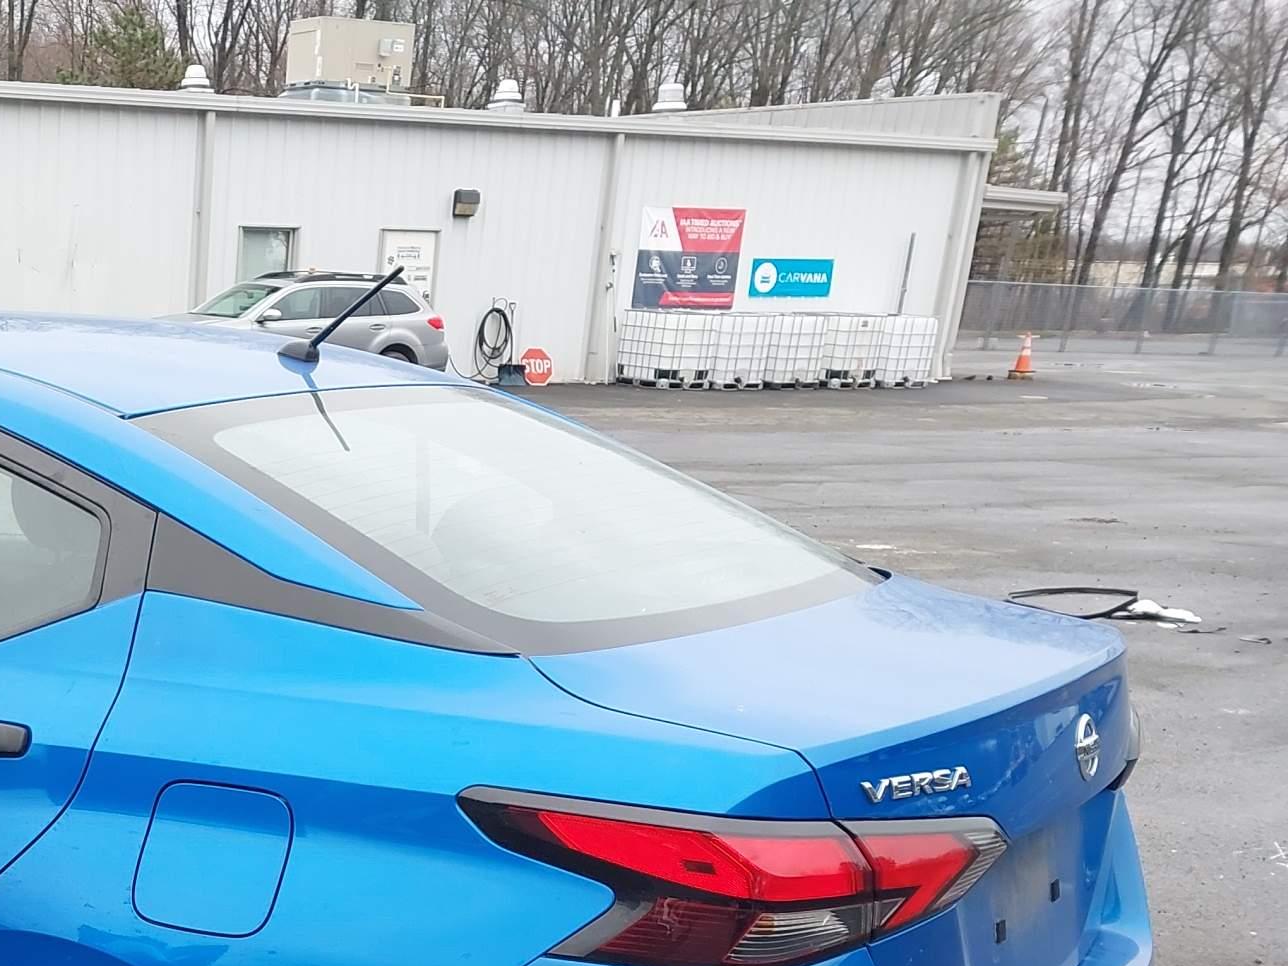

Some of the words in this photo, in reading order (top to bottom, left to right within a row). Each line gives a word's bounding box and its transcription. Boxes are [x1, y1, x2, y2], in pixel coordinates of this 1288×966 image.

[778, 271, 828, 284] CARVANA
[522, 358, 551, 374] STOP
[860, 766, 972, 803] VERSA
